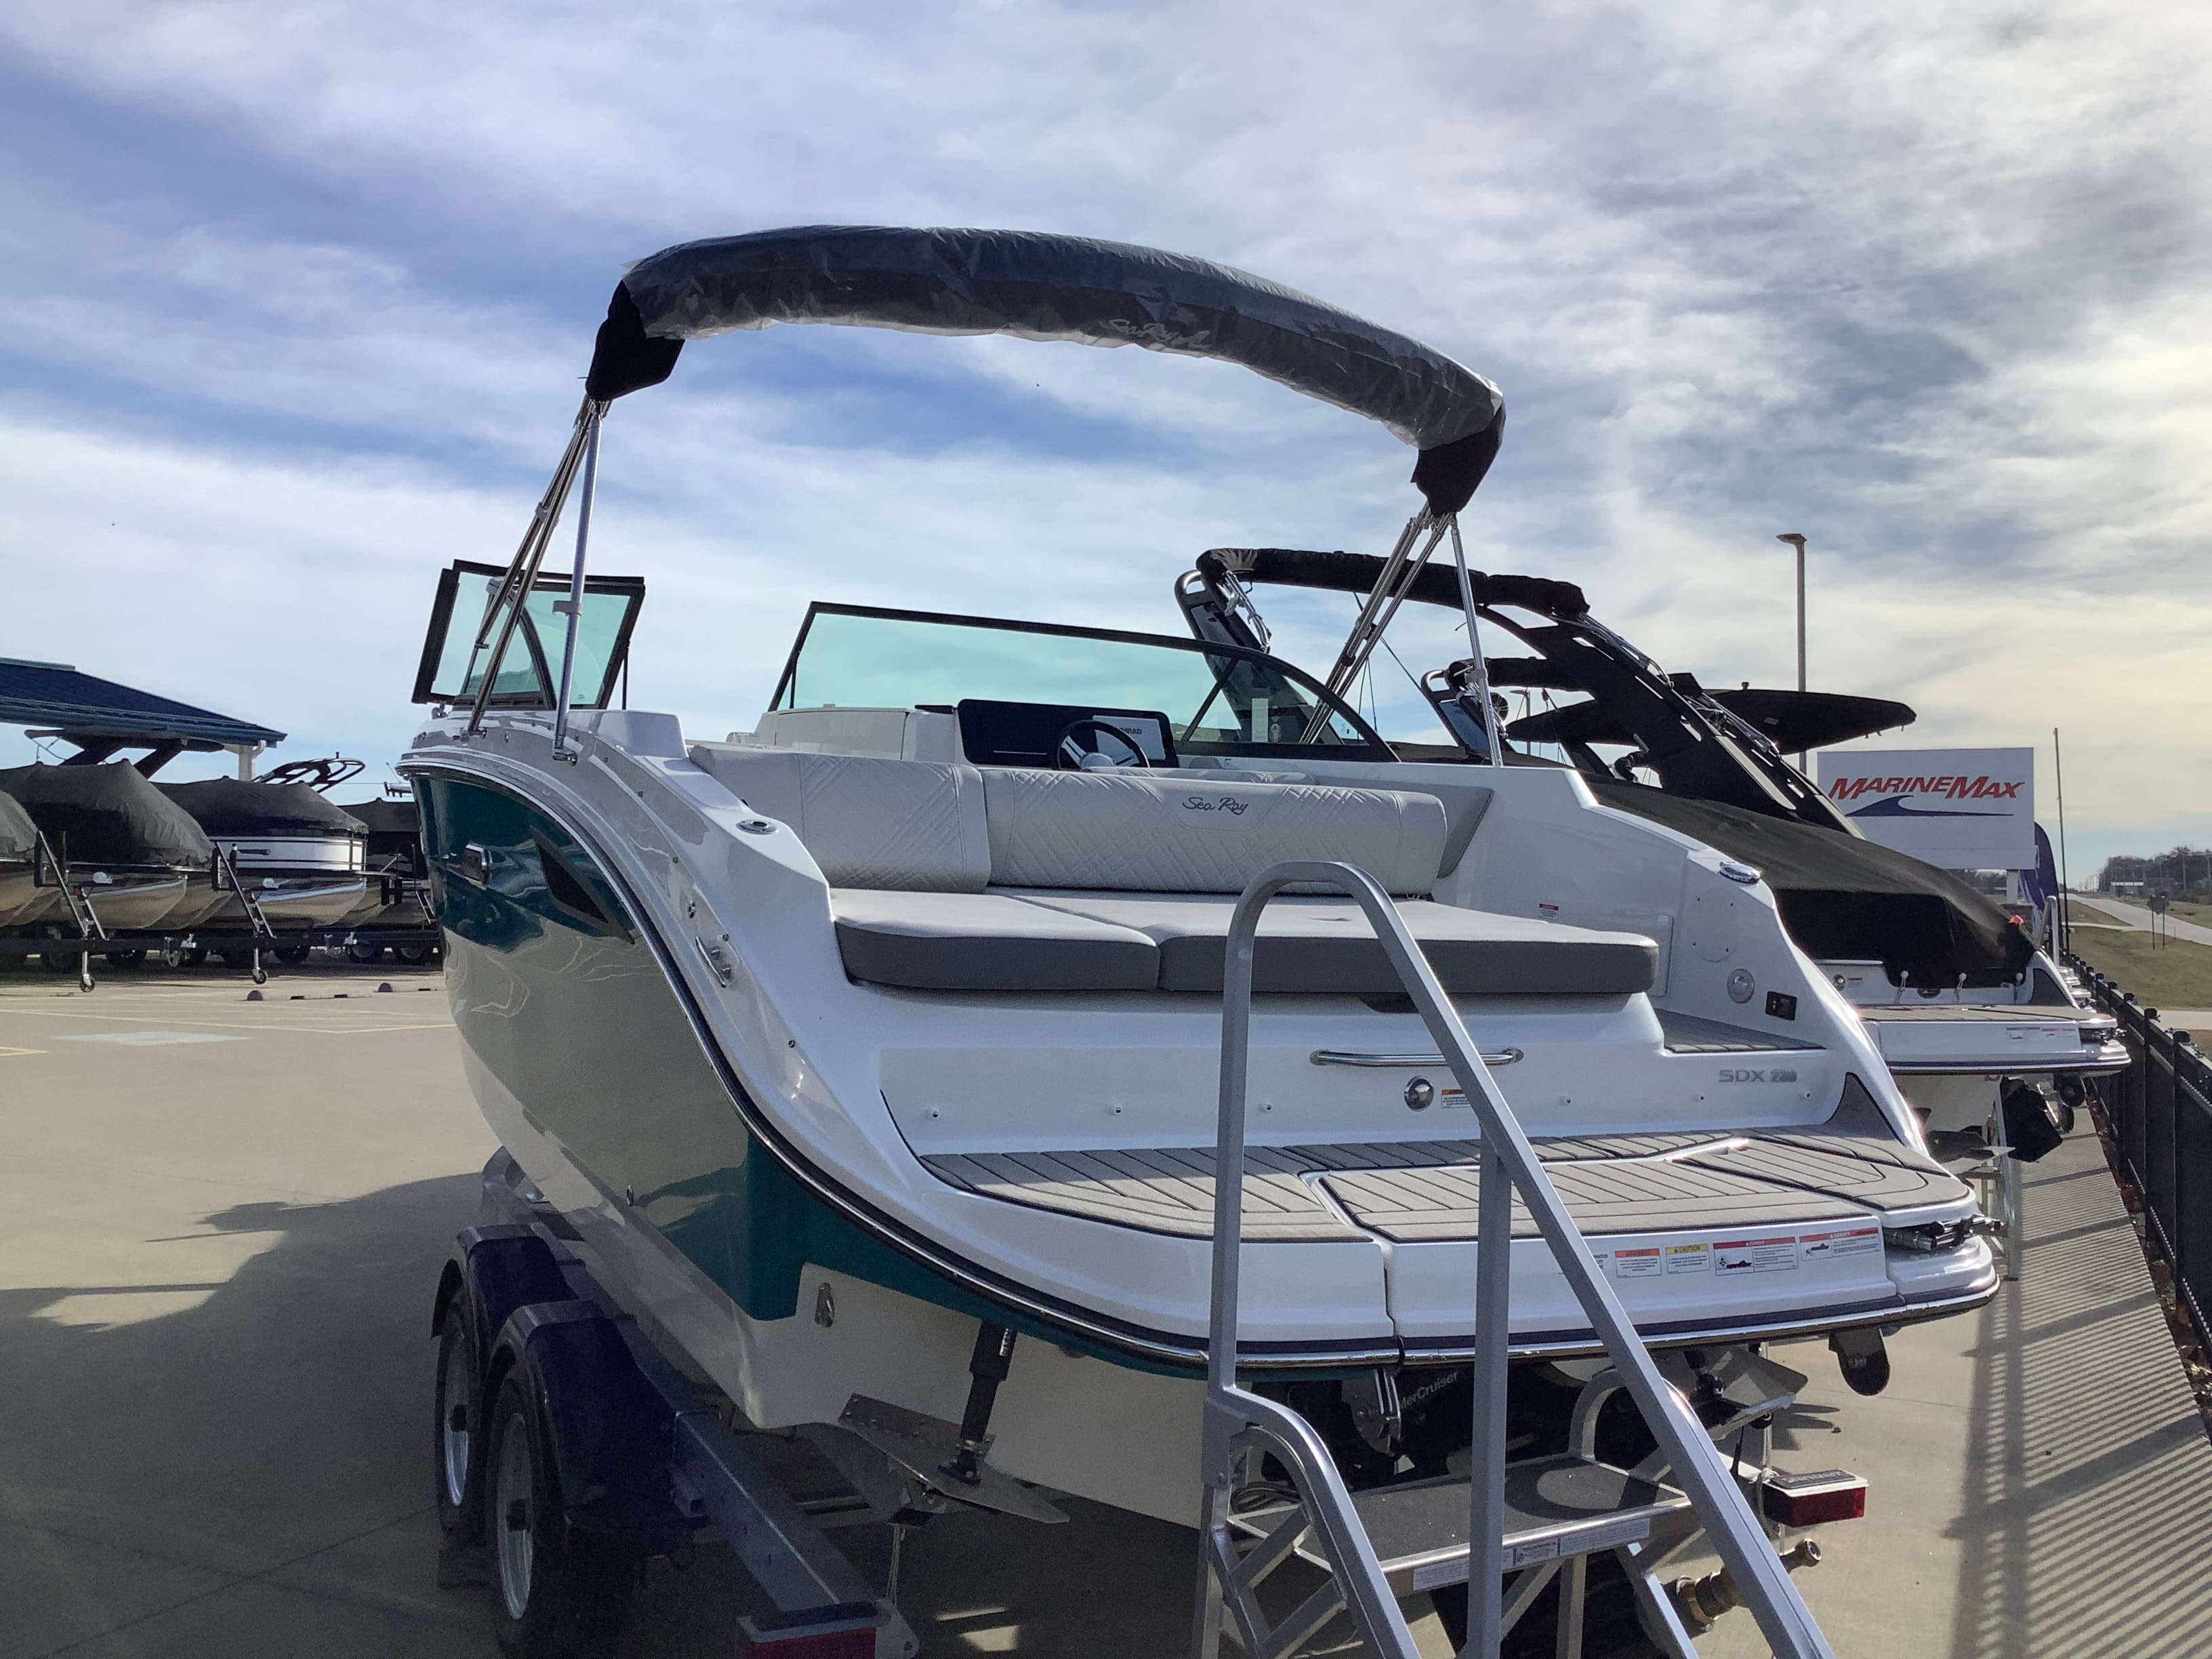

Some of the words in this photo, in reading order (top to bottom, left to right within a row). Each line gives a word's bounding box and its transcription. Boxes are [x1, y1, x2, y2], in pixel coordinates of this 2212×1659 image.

[1182, 796, 1216, 811] Sea
[1218, 797, 1249, 815] Ray
[1719, 1069, 1765, 1083] SDX
[1399, 1370, 1459, 1409] MerCruiser
